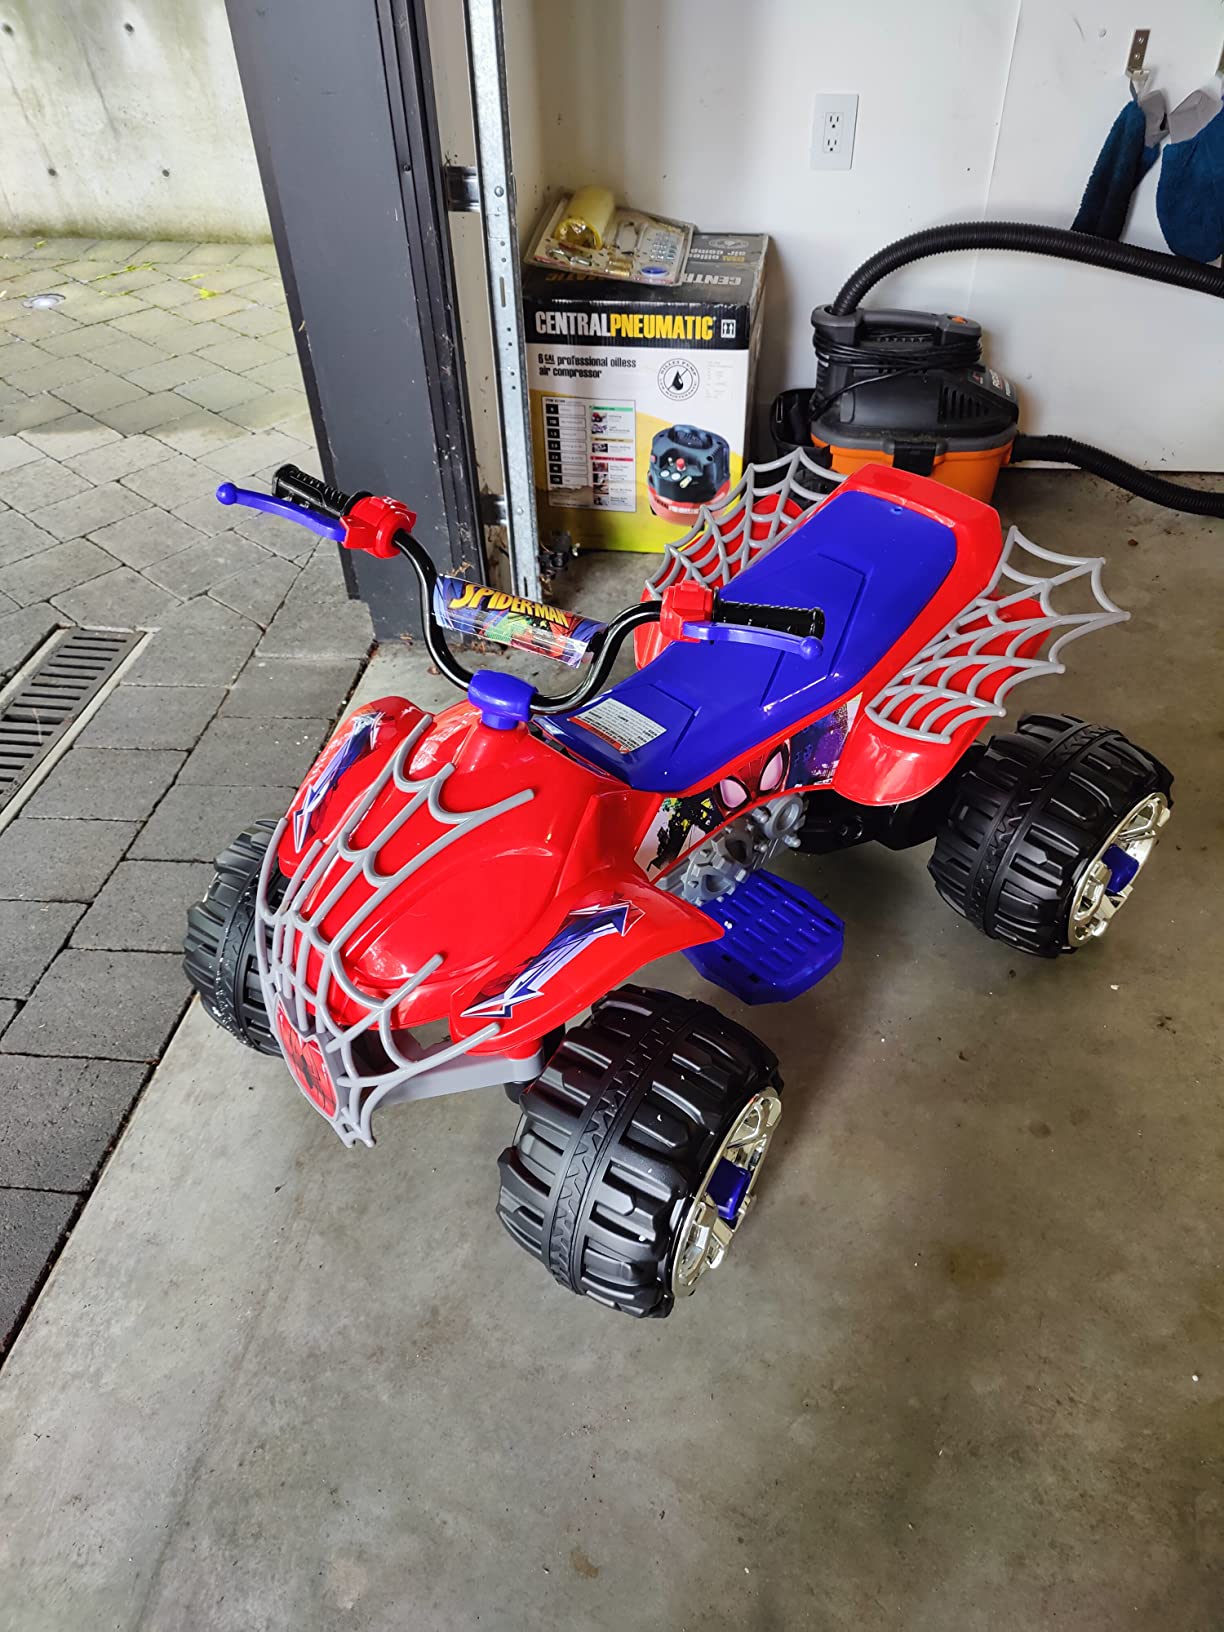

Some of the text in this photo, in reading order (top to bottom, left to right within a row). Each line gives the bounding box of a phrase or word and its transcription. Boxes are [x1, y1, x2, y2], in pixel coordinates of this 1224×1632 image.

[537, 353, 544, 364] 6
[557, 355, 608, 367] professional
[610, 357, 636, 368] oilless
[538, 365, 602, 379] air compressor
[448, 583, 570, 628] SPIDER-MAN
